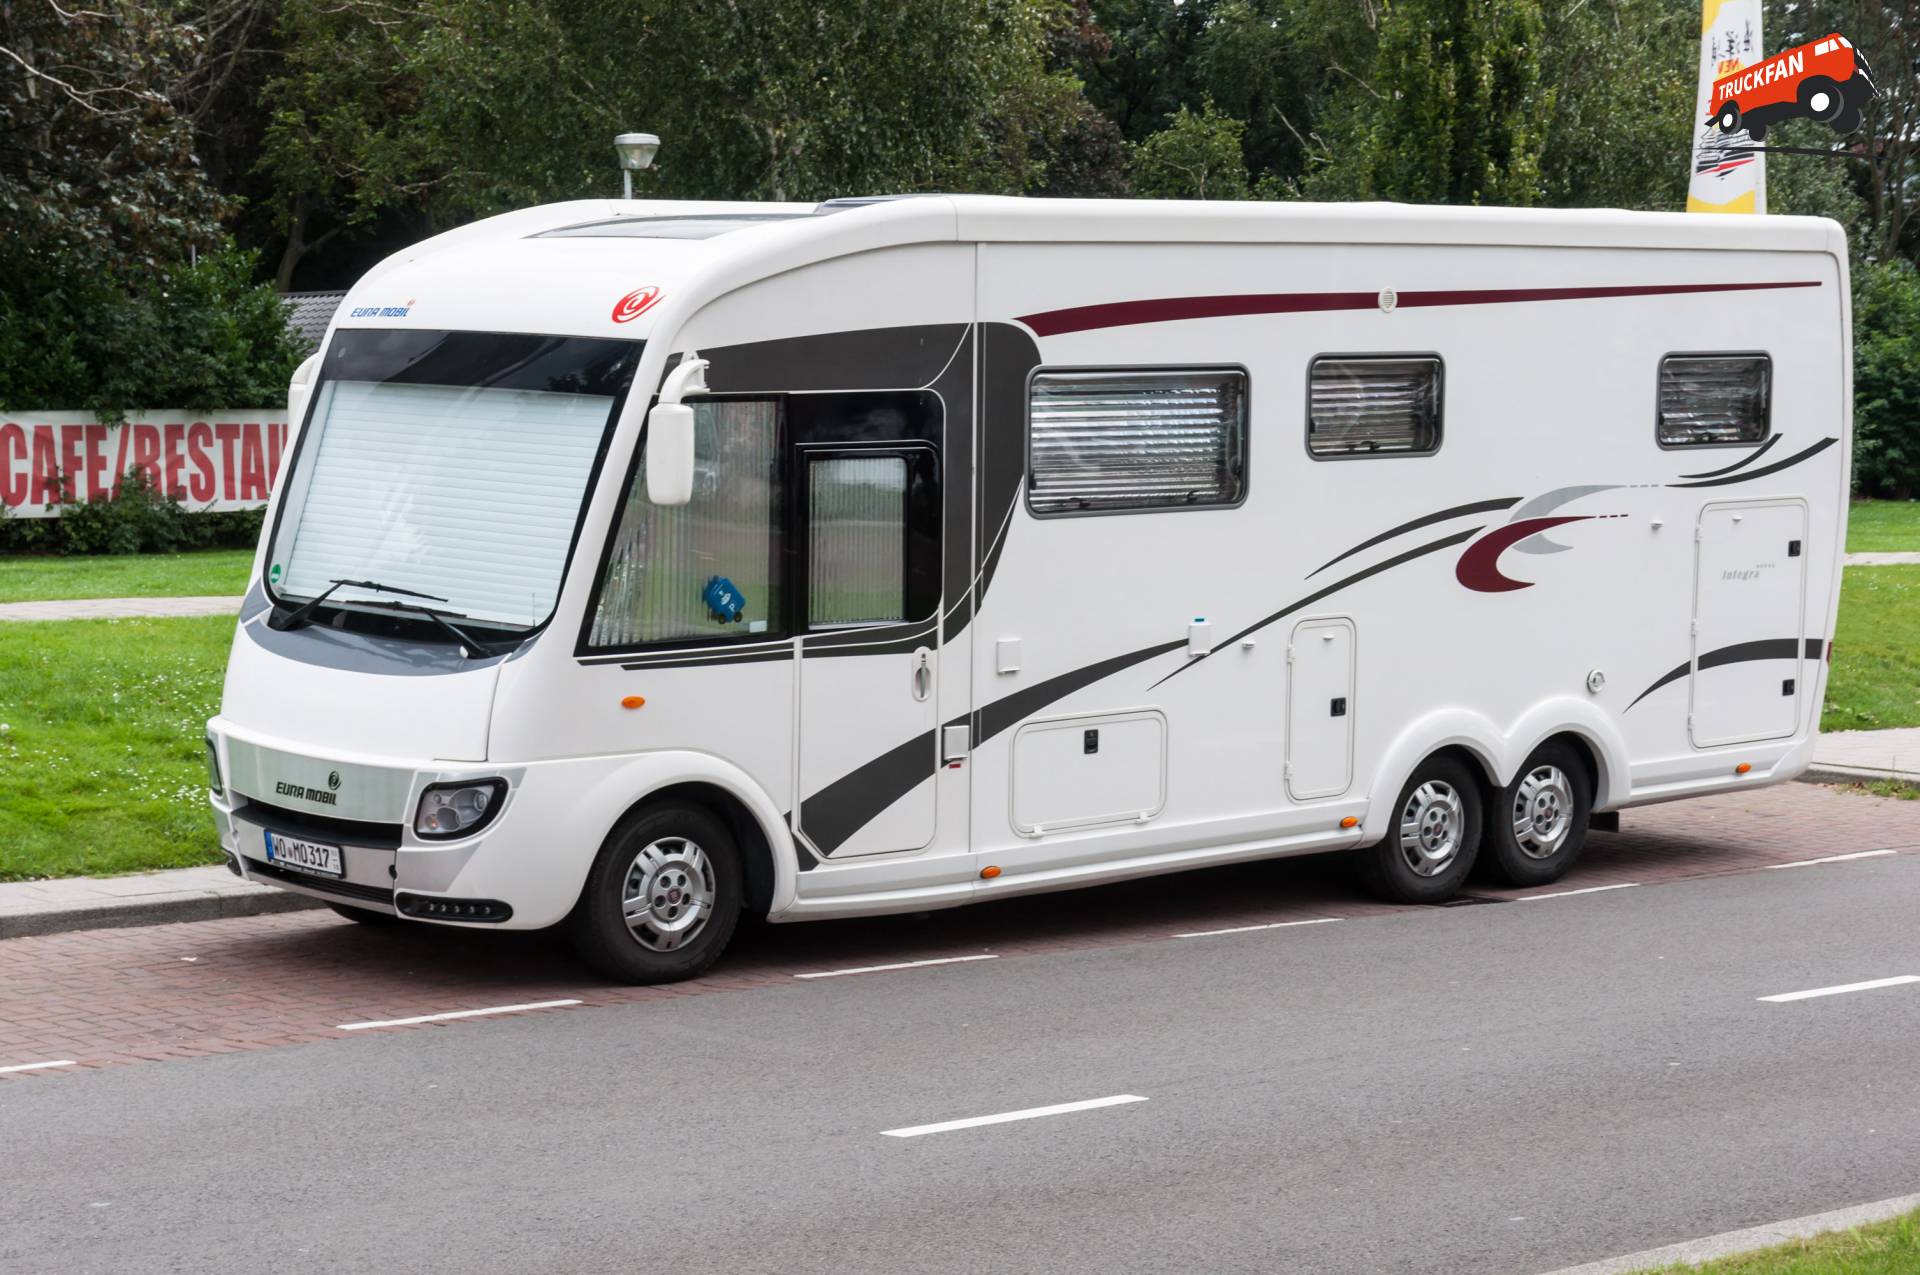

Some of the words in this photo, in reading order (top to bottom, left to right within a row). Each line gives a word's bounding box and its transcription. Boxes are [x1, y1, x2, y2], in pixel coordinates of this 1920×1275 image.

[379, 307, 410, 317] MOBIL
[276, 781, 305, 799] EURA
[306, 788, 337, 806] MOBIL
